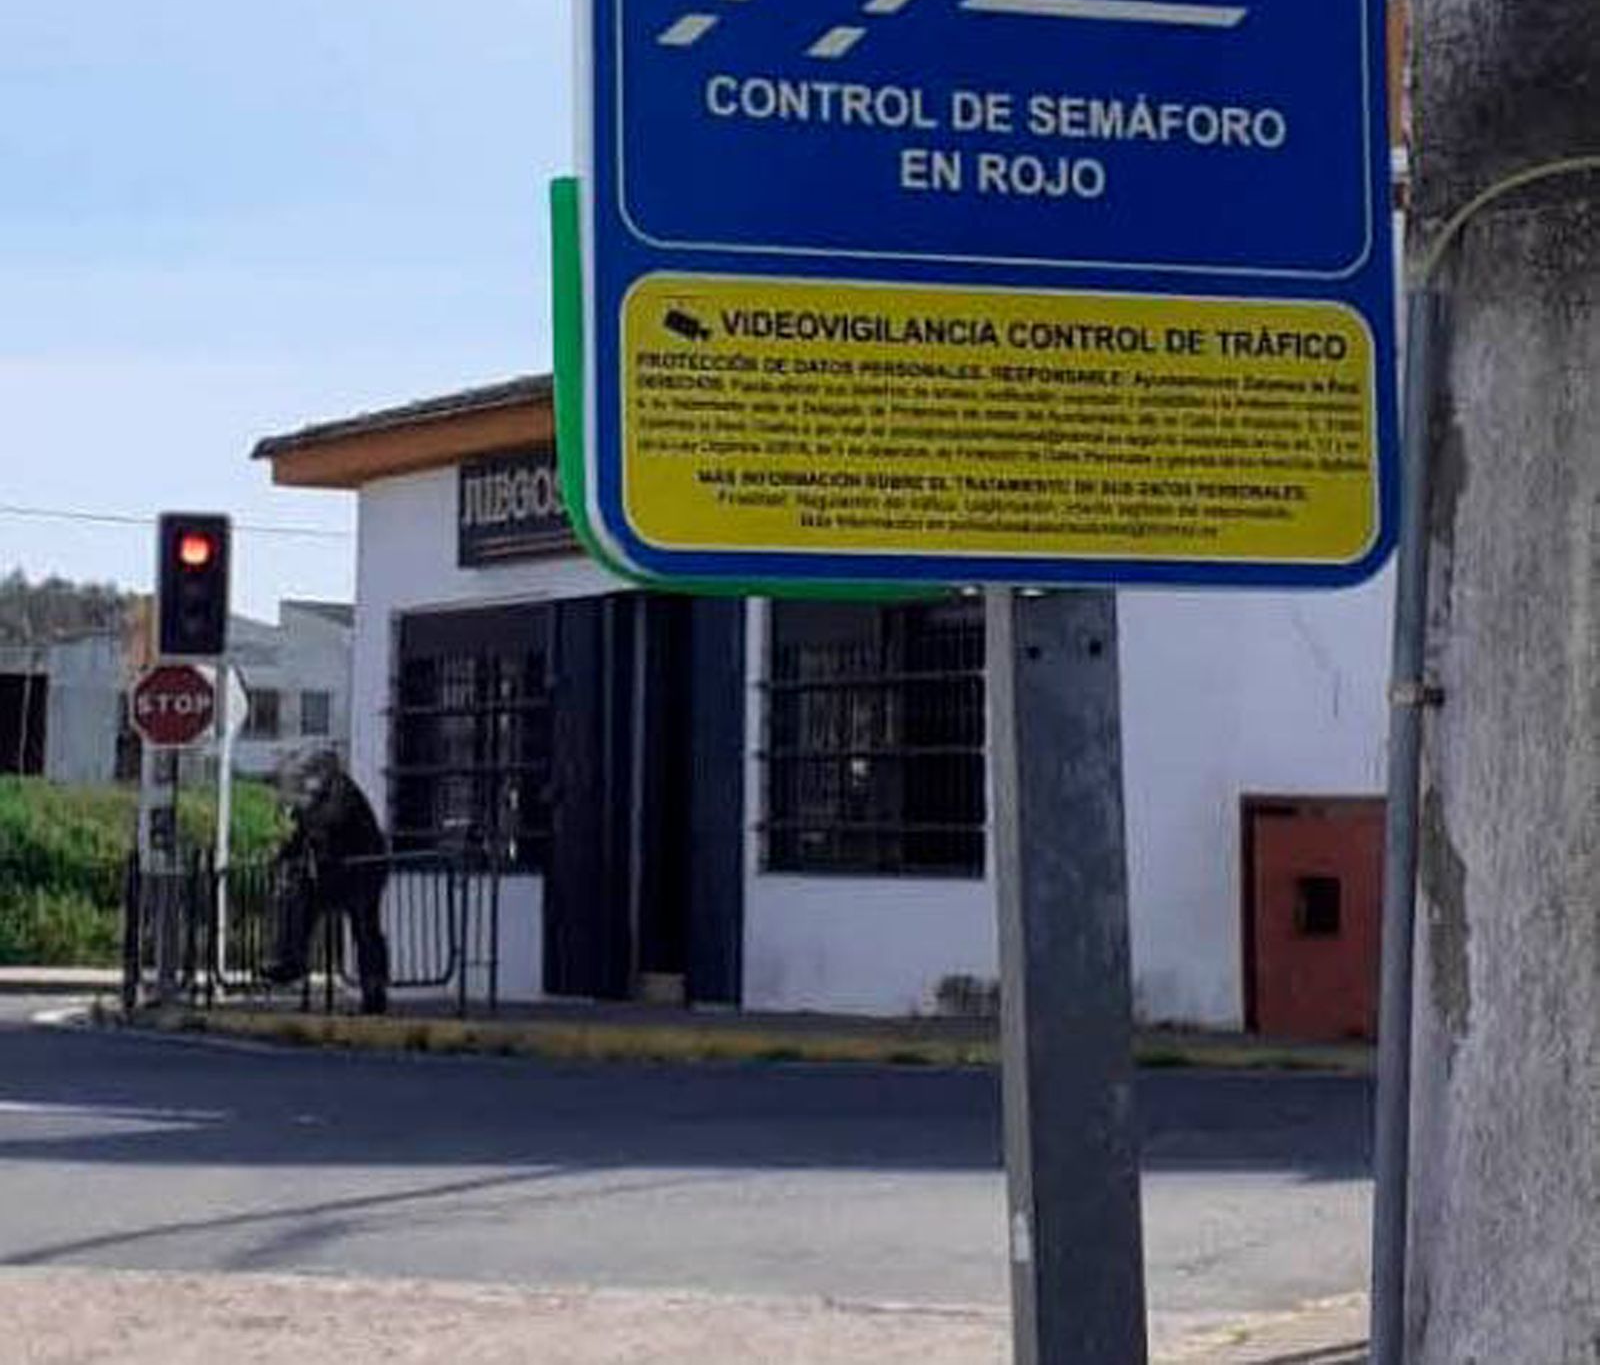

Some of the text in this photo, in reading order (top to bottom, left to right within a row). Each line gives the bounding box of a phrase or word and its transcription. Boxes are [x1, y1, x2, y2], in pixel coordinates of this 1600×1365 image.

[706, 74, 1287, 148] CONTROL DE SEMÁFORO
[900, 148, 1106, 198] EN ROJO
[721, 310, 1348, 361] VIDEOVIGILANCIA CONTROL DE TRÁFICO
[138, 693, 210, 715] STOP
